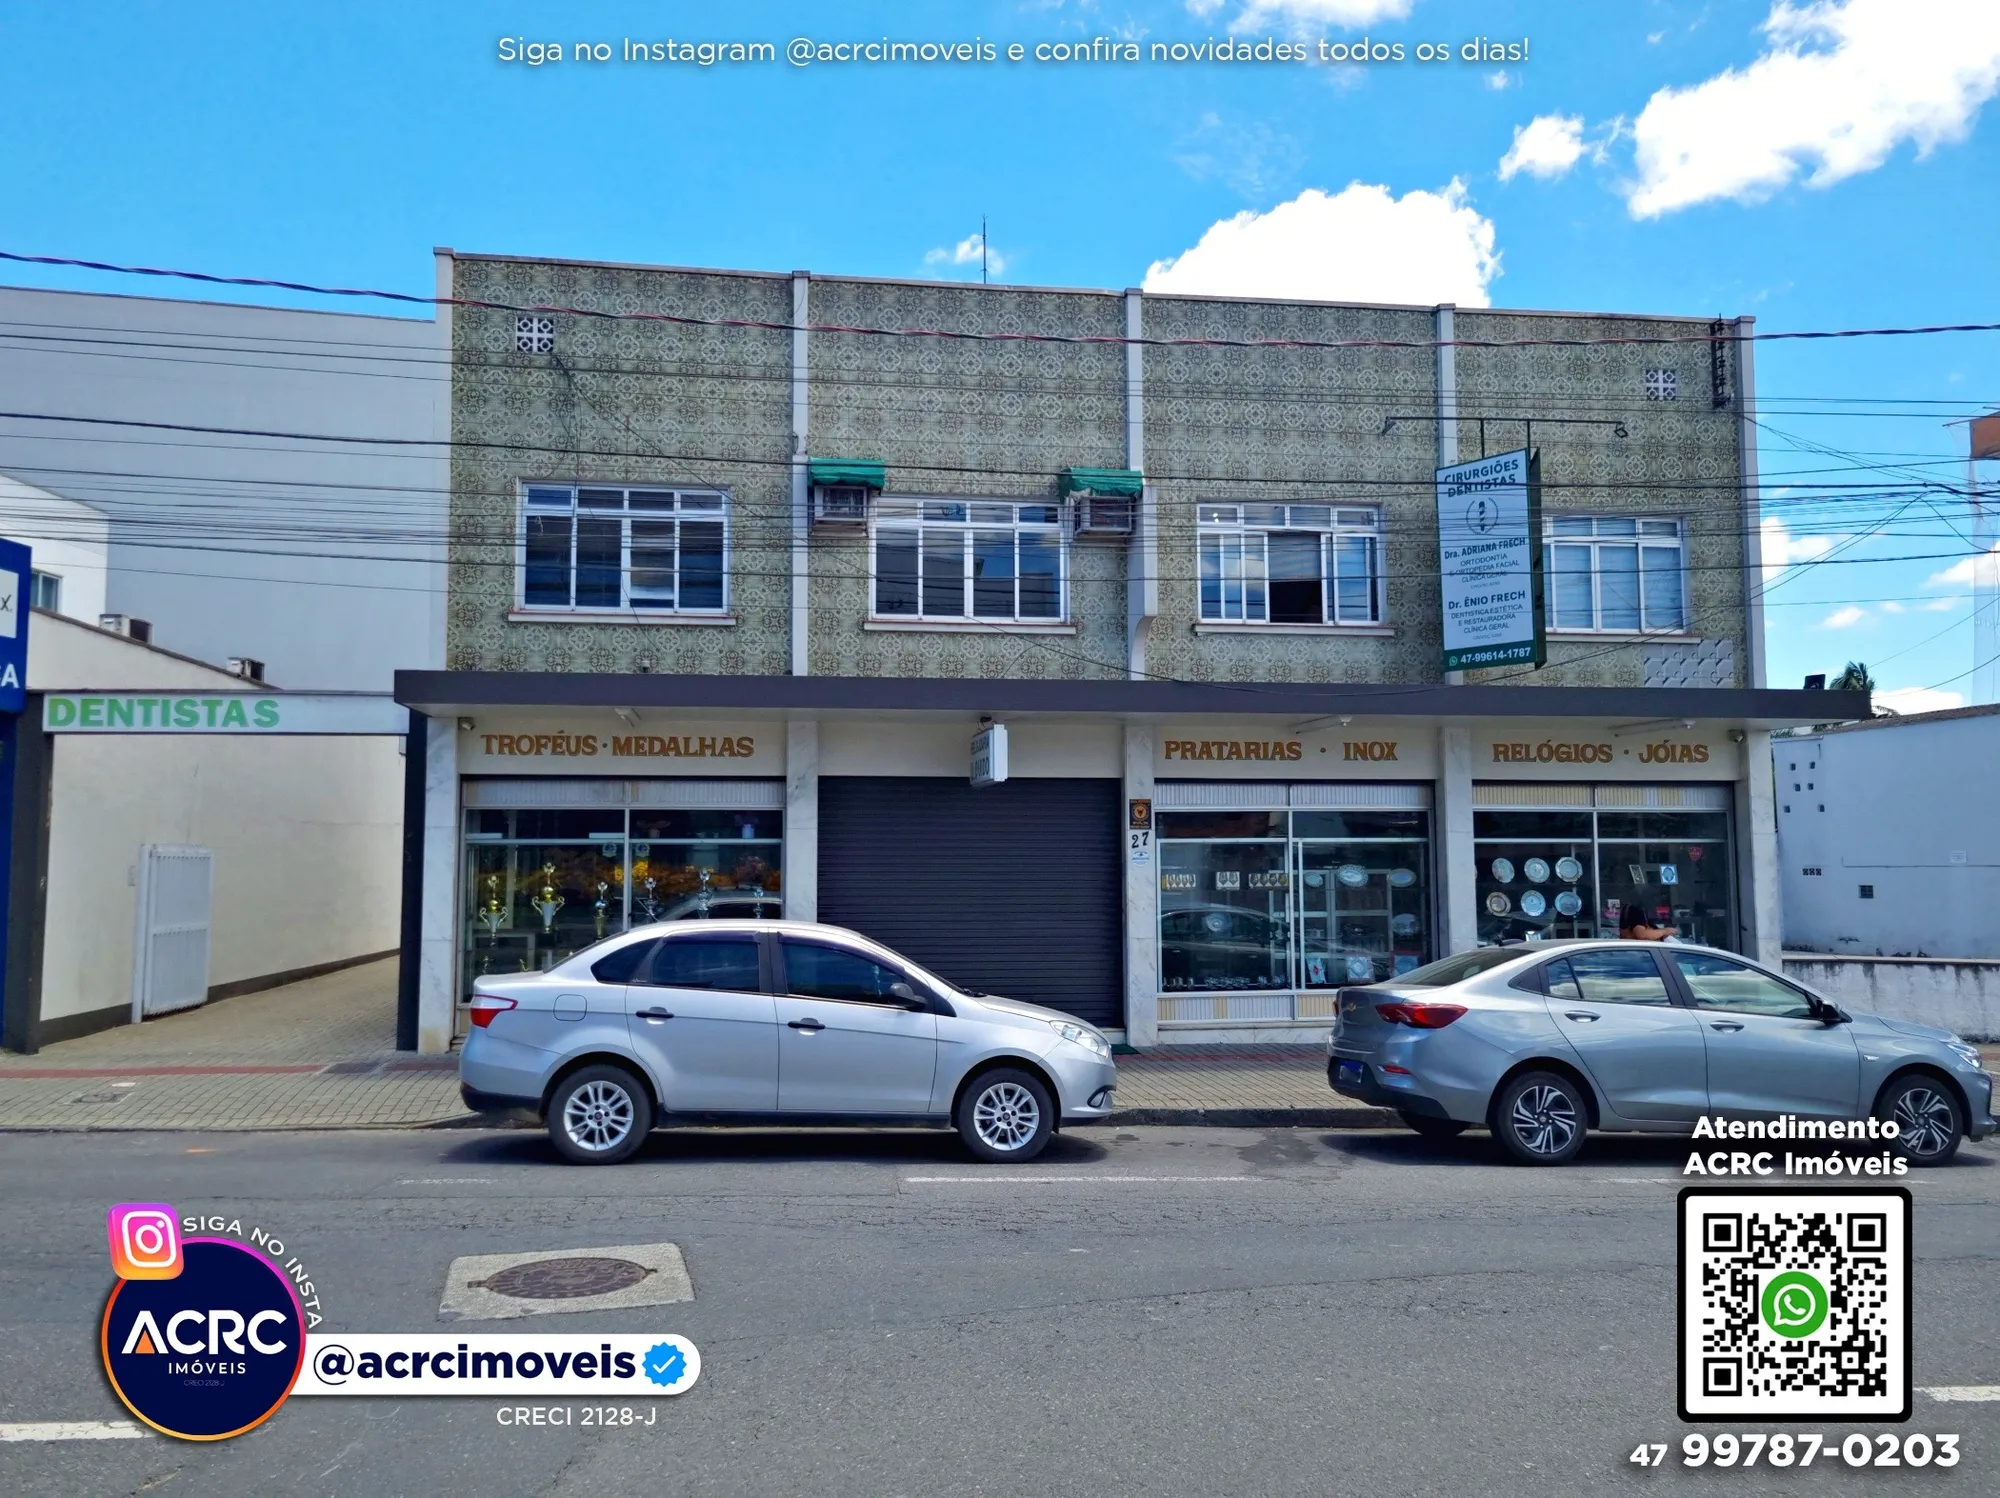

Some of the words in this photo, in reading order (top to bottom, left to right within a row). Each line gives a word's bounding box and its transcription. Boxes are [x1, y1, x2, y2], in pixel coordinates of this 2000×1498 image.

[1444, 459, 1519, 484] CIRURGIÕES
[1448, 474, 1516, 497] DENTISTAS
[1444, 550, 1460, 560] Dra.
[1461, 542, 1497, 557] ADRIANA
[1498, 537, 1526, 550] FRECH
[1460, 553, 1508, 567] ORTODONTIA
[1496, 559, 1519, 570] FACIAL
[1448, 600, 1462, 610] Dr.
[1464, 596, 1488, 608] ÊNIO
[1490, 590, 1526, 604] FRECH
[1489, 603, 1523, 614] ESTÉTICA
[1463, 613, 1517, 625] RESTAURADORA
[1463, 625, 1488, 634] CLÍNICA
[1488, 622, 1510, 631] GERAL
[1460, 647, 1531, 664] 47-99614-1787
[48, 698, 280, 728] DENTISTAS
[480, 730, 599, 757] TROFÉUS
[611, 735, 755, 758] MEDALHAS
[1164, 740, 1302, 761] PRATARIAS
[1343, 741, 1398, 761] INOX
[1492, 739, 1613, 763] RELÓGIOS
[1638, 739, 1710, 763] JÓIAS
[1131, 831, 1149, 849] 27
